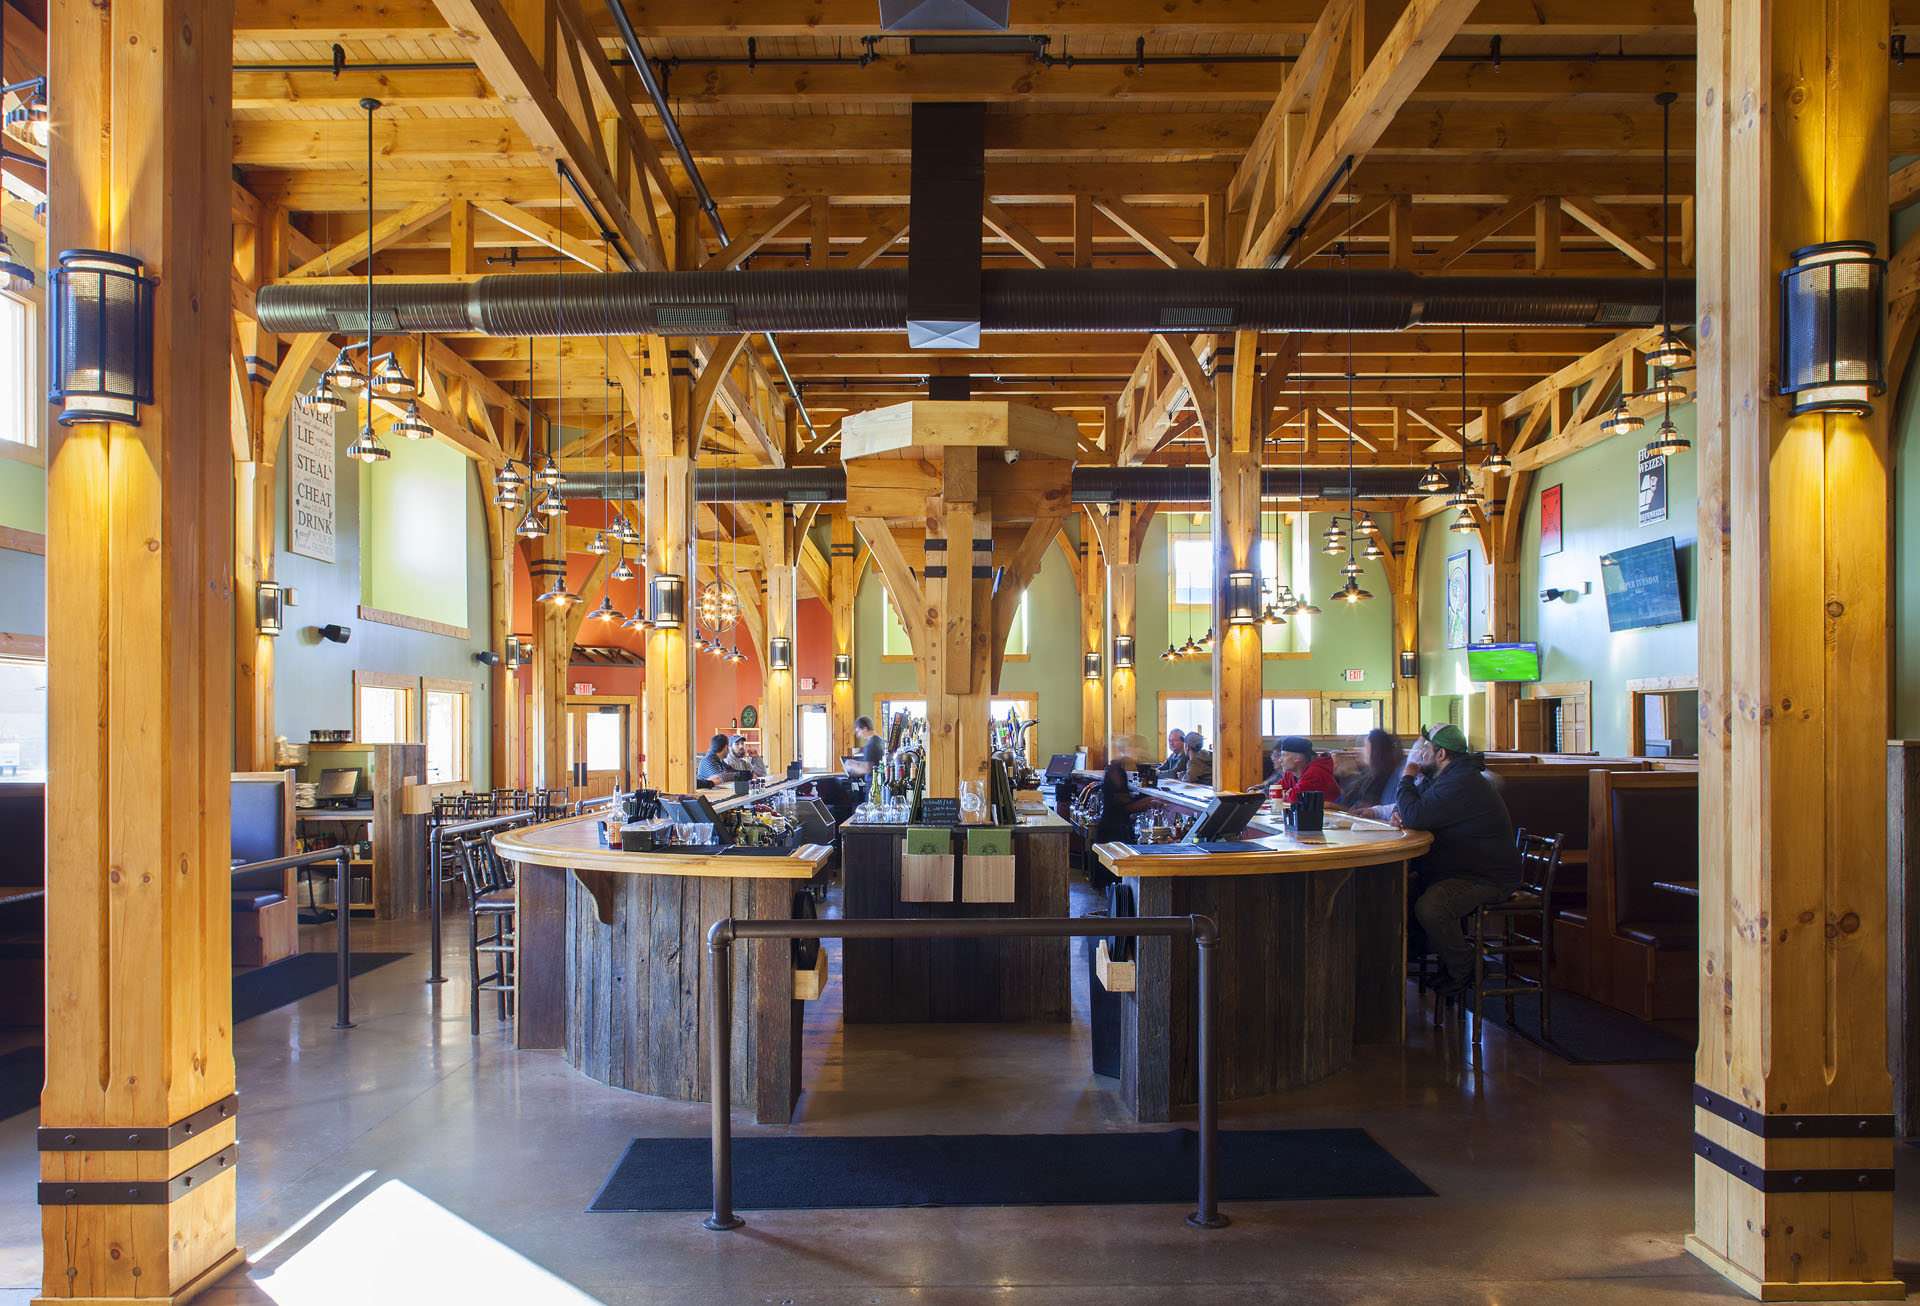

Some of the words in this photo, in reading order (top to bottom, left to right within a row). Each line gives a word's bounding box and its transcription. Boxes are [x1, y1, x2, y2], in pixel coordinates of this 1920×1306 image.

[297, 425, 314, 446] LIE
[297, 453, 330, 480] STEAL
[1639, 455, 1665, 473] WEIZEN
[297, 483, 332, 507] CHEAT
[298, 510, 333, 535] DRINK
[1349, 670, 1361, 681] EXIT
